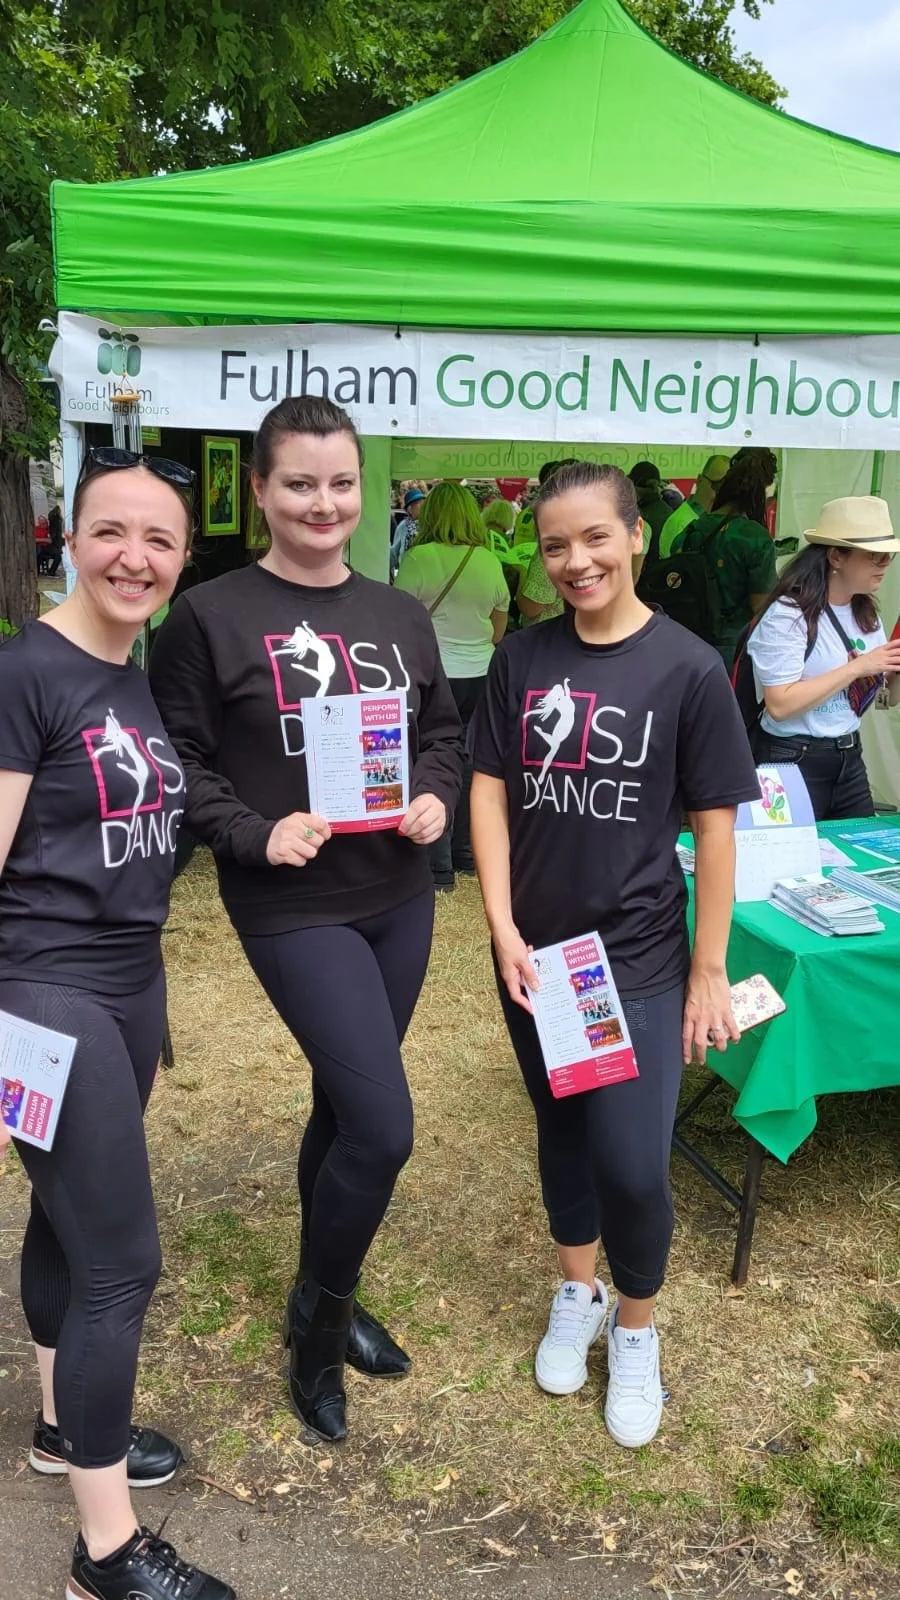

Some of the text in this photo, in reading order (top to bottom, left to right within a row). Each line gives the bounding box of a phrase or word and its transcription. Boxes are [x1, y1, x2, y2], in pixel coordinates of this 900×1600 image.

[68, 398, 99, 412] Good
[85, 381, 152, 402] Fulham
[219, 349, 900, 430] Fulham Good Neighbou
[349, 642, 411, 692] SJ
[363, 703, 399, 712] PERFORM
[365, 712, 398, 722] WITH US!
[587, 705, 654, 768] SJ
[147, 737, 187, 794] S
[523, 772, 642, 822] DANCE
[101, 808, 185, 868] DANC
[565, 943, 595, 958] PERFORM
[568, 951, 597, 965] WITH US!
[29, 1095, 39, 1118] WITH
[34, 1095, 49, 1138] PERFORM
